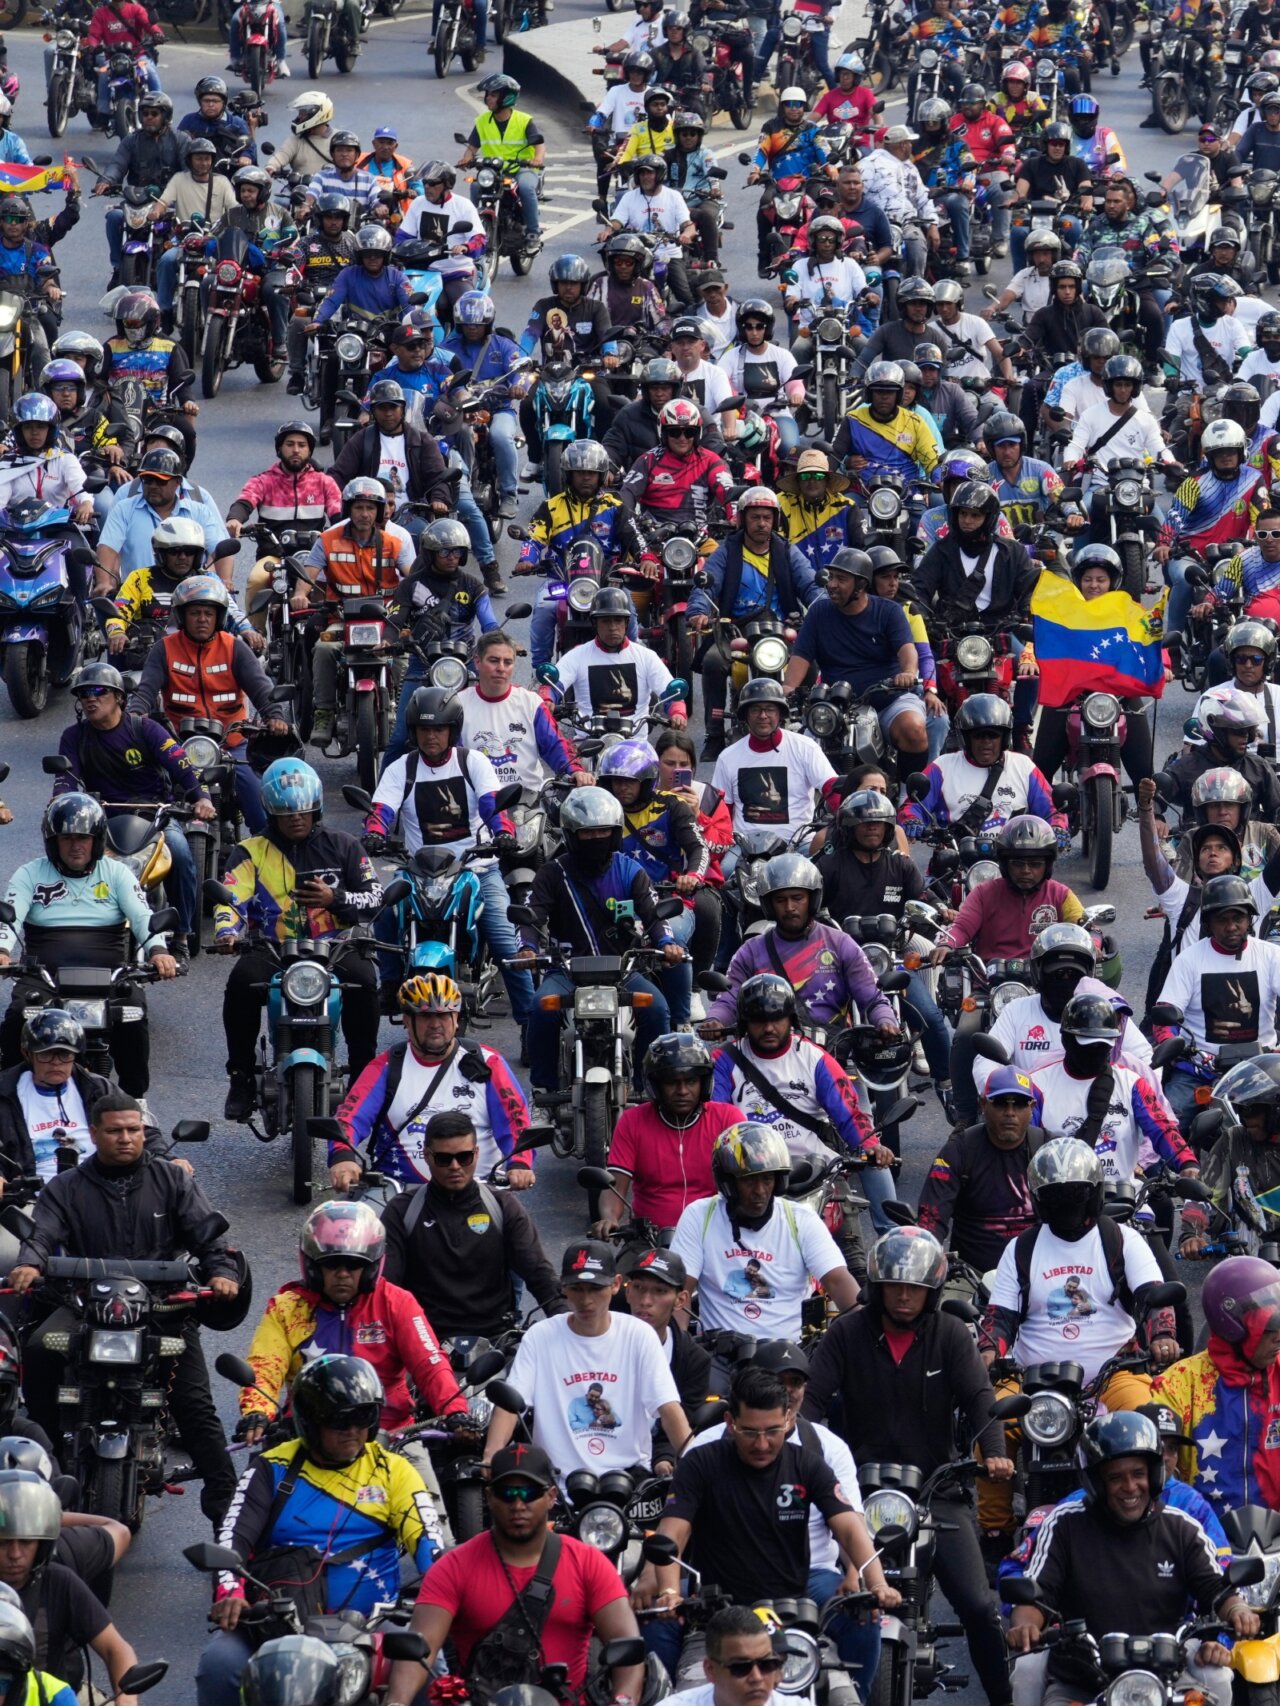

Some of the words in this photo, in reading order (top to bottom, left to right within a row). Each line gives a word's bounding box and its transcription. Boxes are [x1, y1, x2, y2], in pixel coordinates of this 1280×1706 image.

[1019, 1041, 1051, 1051] TORO
[32, 1119, 78, 1133] LIBERTAD
[725, 1249, 773, 1262] LIBERTAD
[1042, 1265, 1094, 1280] LIBERTAD
[562, 1372, 619, 1387] LIBERTAD
